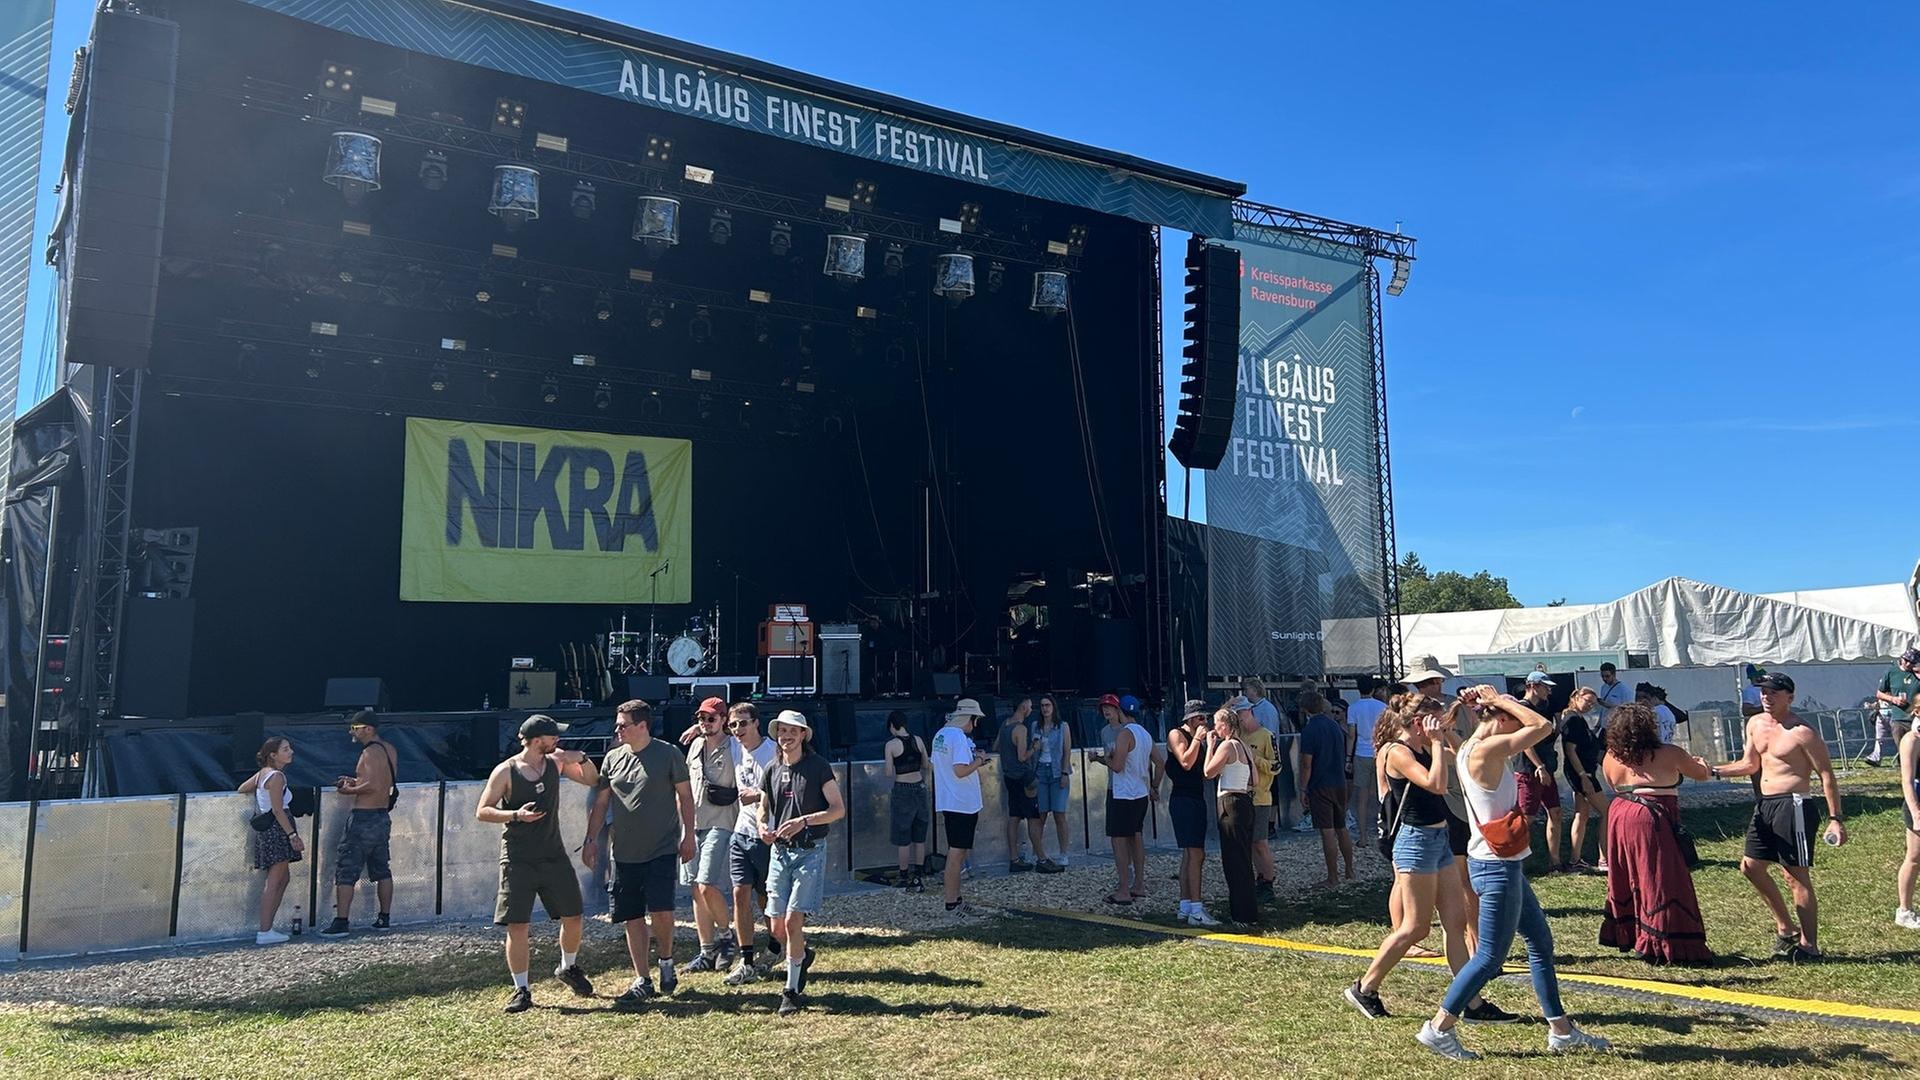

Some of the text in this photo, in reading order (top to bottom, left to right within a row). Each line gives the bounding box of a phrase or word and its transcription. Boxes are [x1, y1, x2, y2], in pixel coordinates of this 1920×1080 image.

[766, 96, 862, 149] FINEST
[875, 123, 989, 181] FESTIVAL
[1251, 266, 1333, 295] Kreissparkasse
[1251, 286, 1317, 313] Ravensburg
[1245, 397, 1326, 443] FINEST
[1232, 437, 1343, 486] FESTIVAL
[447, 439, 659, 553] NIKRA
[1271, 631, 1316, 642] Sunlight
